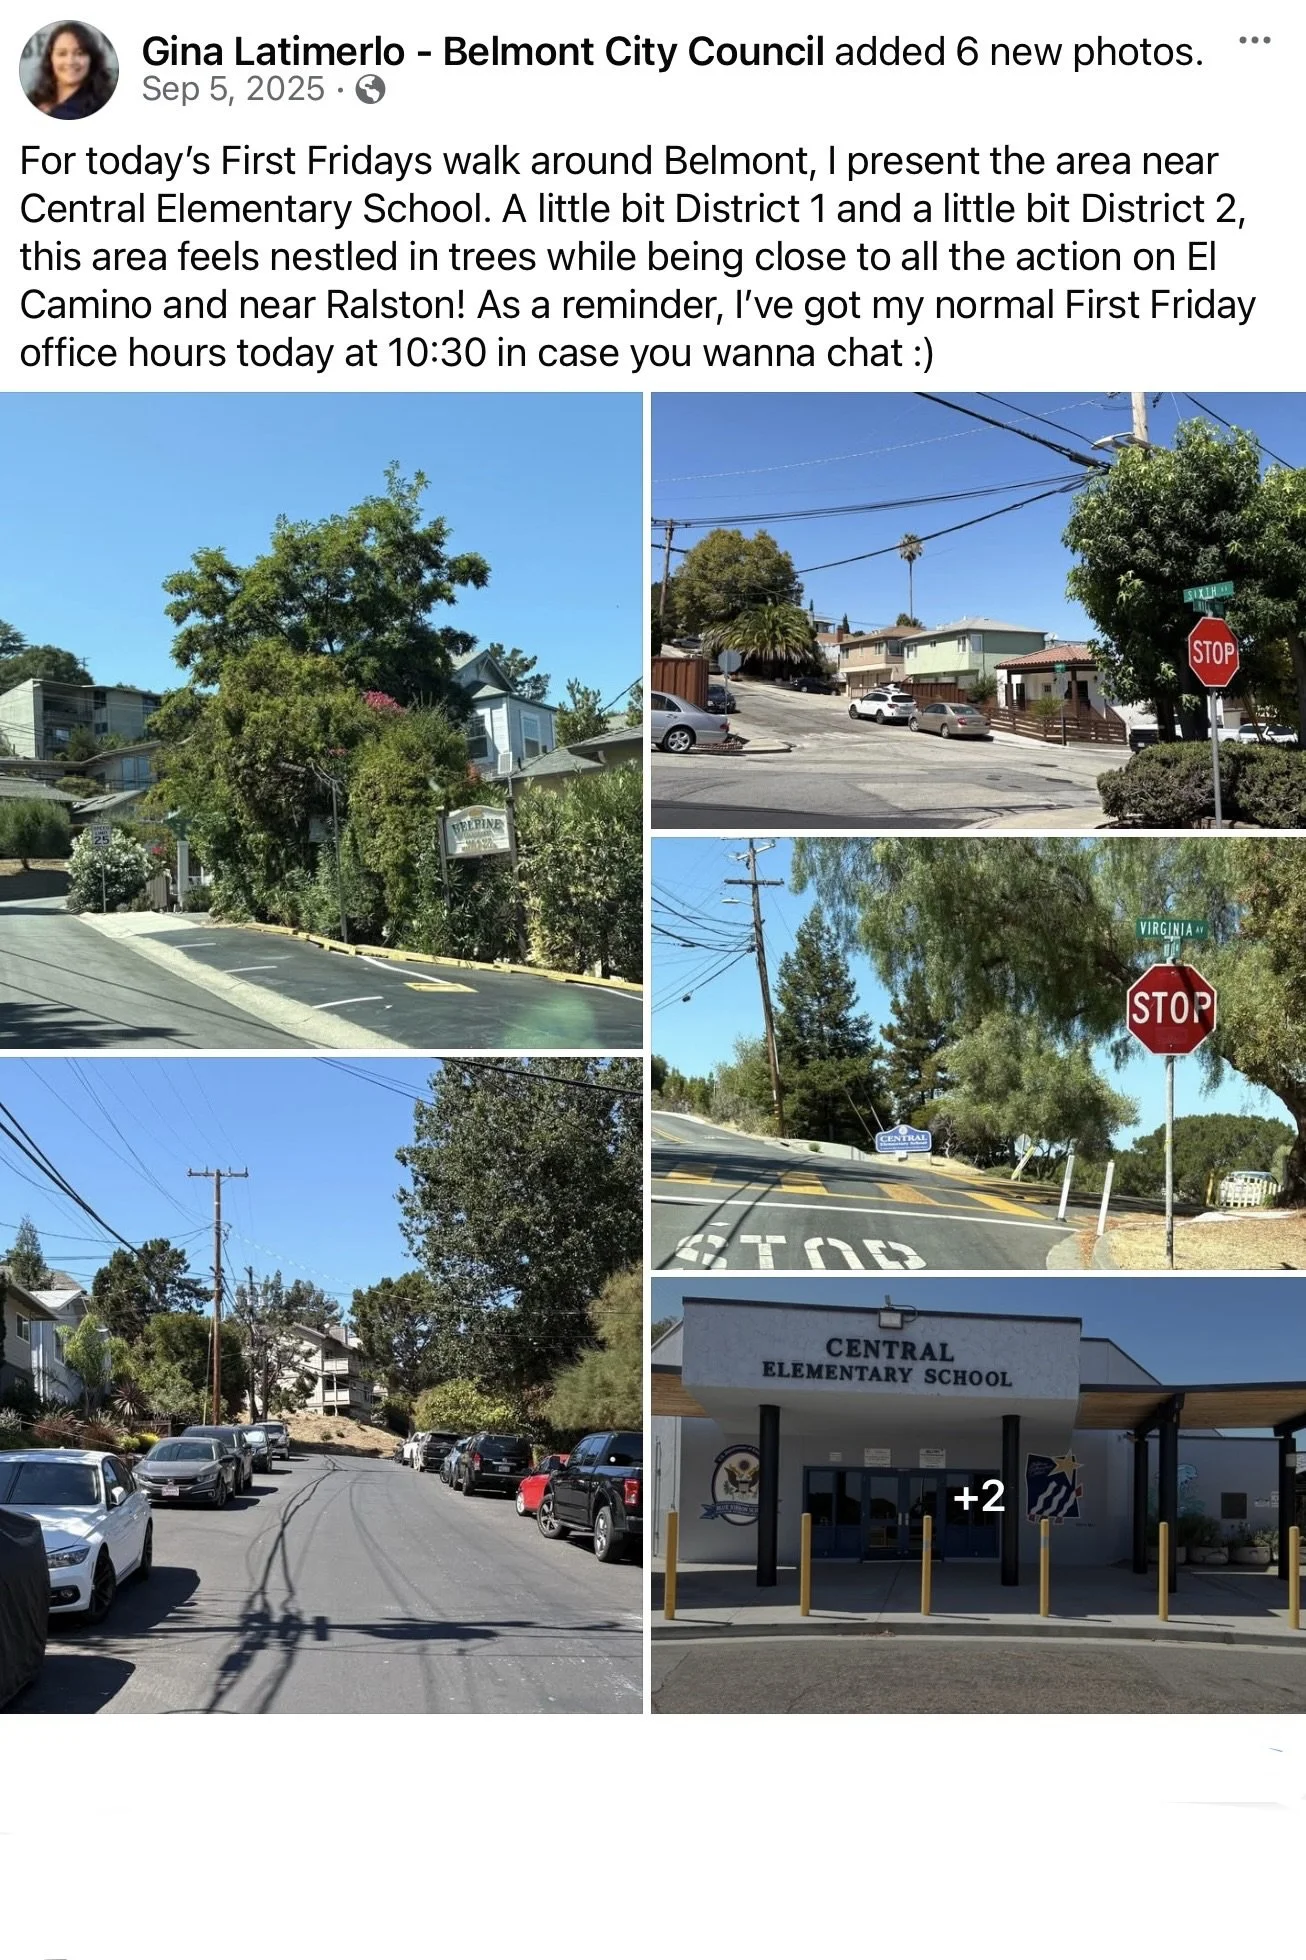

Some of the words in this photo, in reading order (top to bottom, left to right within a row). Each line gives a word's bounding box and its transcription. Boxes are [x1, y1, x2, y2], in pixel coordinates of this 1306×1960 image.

[1187, 586, 1217, 601] SIXTH
[1193, 640, 1235, 664] STOP
[94, 835, 110, 845] 25
[1140, 921, 1193, 936] VIRGINIA
[1195, 926, 1204, 934] AV
[1132, 991, 1212, 1024] STOP
[880, 1134, 928, 1142] CENTRAL
[825, 1337, 955, 1362] CENTRAL
[762, 1360, 914, 1383] ELEMENTARY
[923, 1368, 1013, 1387] SCHOOL
